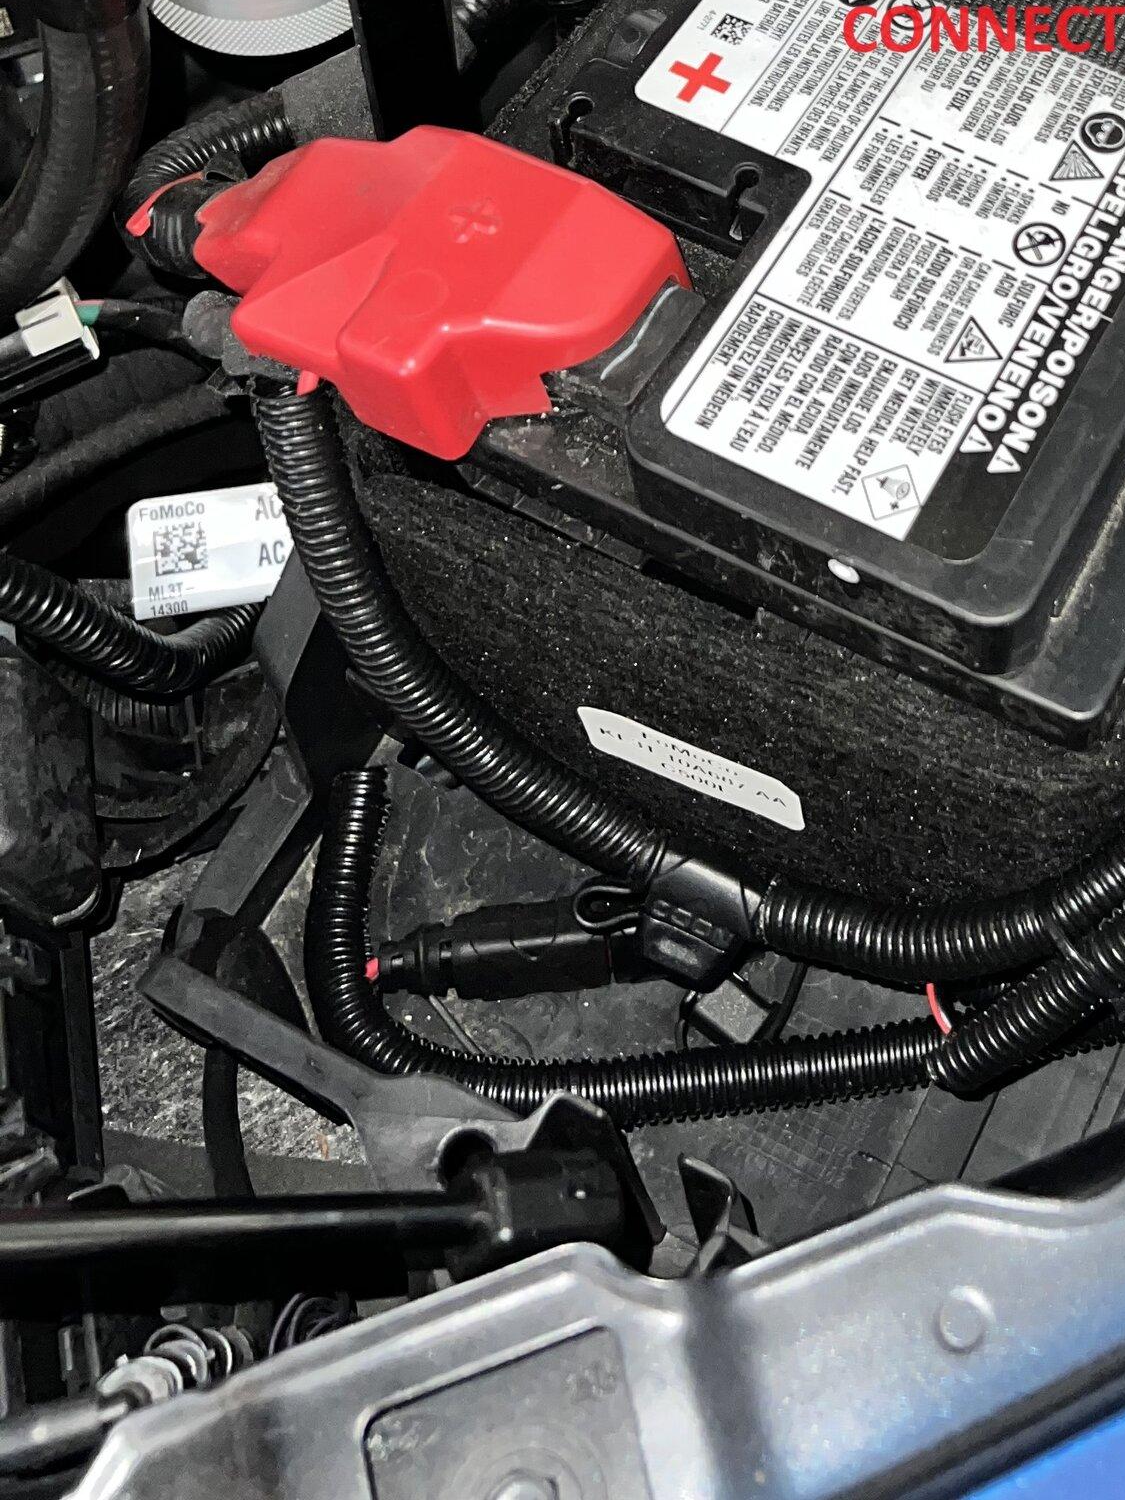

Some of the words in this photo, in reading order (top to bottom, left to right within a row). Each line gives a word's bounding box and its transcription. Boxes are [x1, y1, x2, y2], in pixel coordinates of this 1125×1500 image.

[767, 6, 801, 42] BATTERY!
[811, 0, 834, 18] LIRE
[793, 15, 823, 44] TOUTES
[783, 41, 805, 58] LES
[882, 51, 904, 68] OUT
[865, 75, 887, 93] THE
[875, 64, 894, 79] OF
[1071, 61, 1092, 80] CAN
[850, 89, 878, 116] REACH
[1057, 76, 1083, 103] CAUSE
[1069, 67, 1108, 115] EXPLOSIVE
[843, 113, 862, 127] OF
[1032, 100, 1069, 144] BLINDNESS
[1052, 111, 1082, 143] GASES
[869, 131, 888, 145] DE
[882, 137, 903, 155] LES
[851, 142, 881, 173] FUMER
[857, 152, 893, 193] FLAMMES
[909, 146, 947, 183] ÉVITER
[943, 166, 974, 201] FLAMAS
[955, 172, 987, 208] CHISPAS
[973, 180, 1007, 220] SMOKING
[990, 186, 1020, 220] FLAMES
[1005, 191, 1035, 226] SPARKS
[1049, 198, 1071, 216] NO
[991, 271, 1018, 299] ACID
[996, 278, 1036, 329] SULFURIC
[735, 307, 785, 367] CONSULTEZ
[784, 323, 821, 364] RINCEZ
[725, 362, 749, 382] UN
[771, 359, 798, 384] LES
[850, 348, 879, 379] OJOS
[894, 366, 920, 391] GET
[753, 379, 785, 413] YEUX
[853, 357, 899, 414] ENJUAGUE
[911, 375, 941, 407] WITH
[693, 378, 742, 433] MÉDECIN
[747, 408, 770, 424] À
[866, 387, 908, 439] MEDICAL
[903, 383, 957, 457] IMMEDIATELY
[941, 390, 973, 427] FLUSH
[727, 418, 761, 454] L'EAU
[793, 375, 863, 471] INMEDIATAMENTE
[840, 410, 867, 435] LOS
[848, 434, 880, 468] HELP
[925, 424, 954, 456] EYES
[139, 500, 205, 522] FoMoCo
[150, 600, 189, 617] 14300
